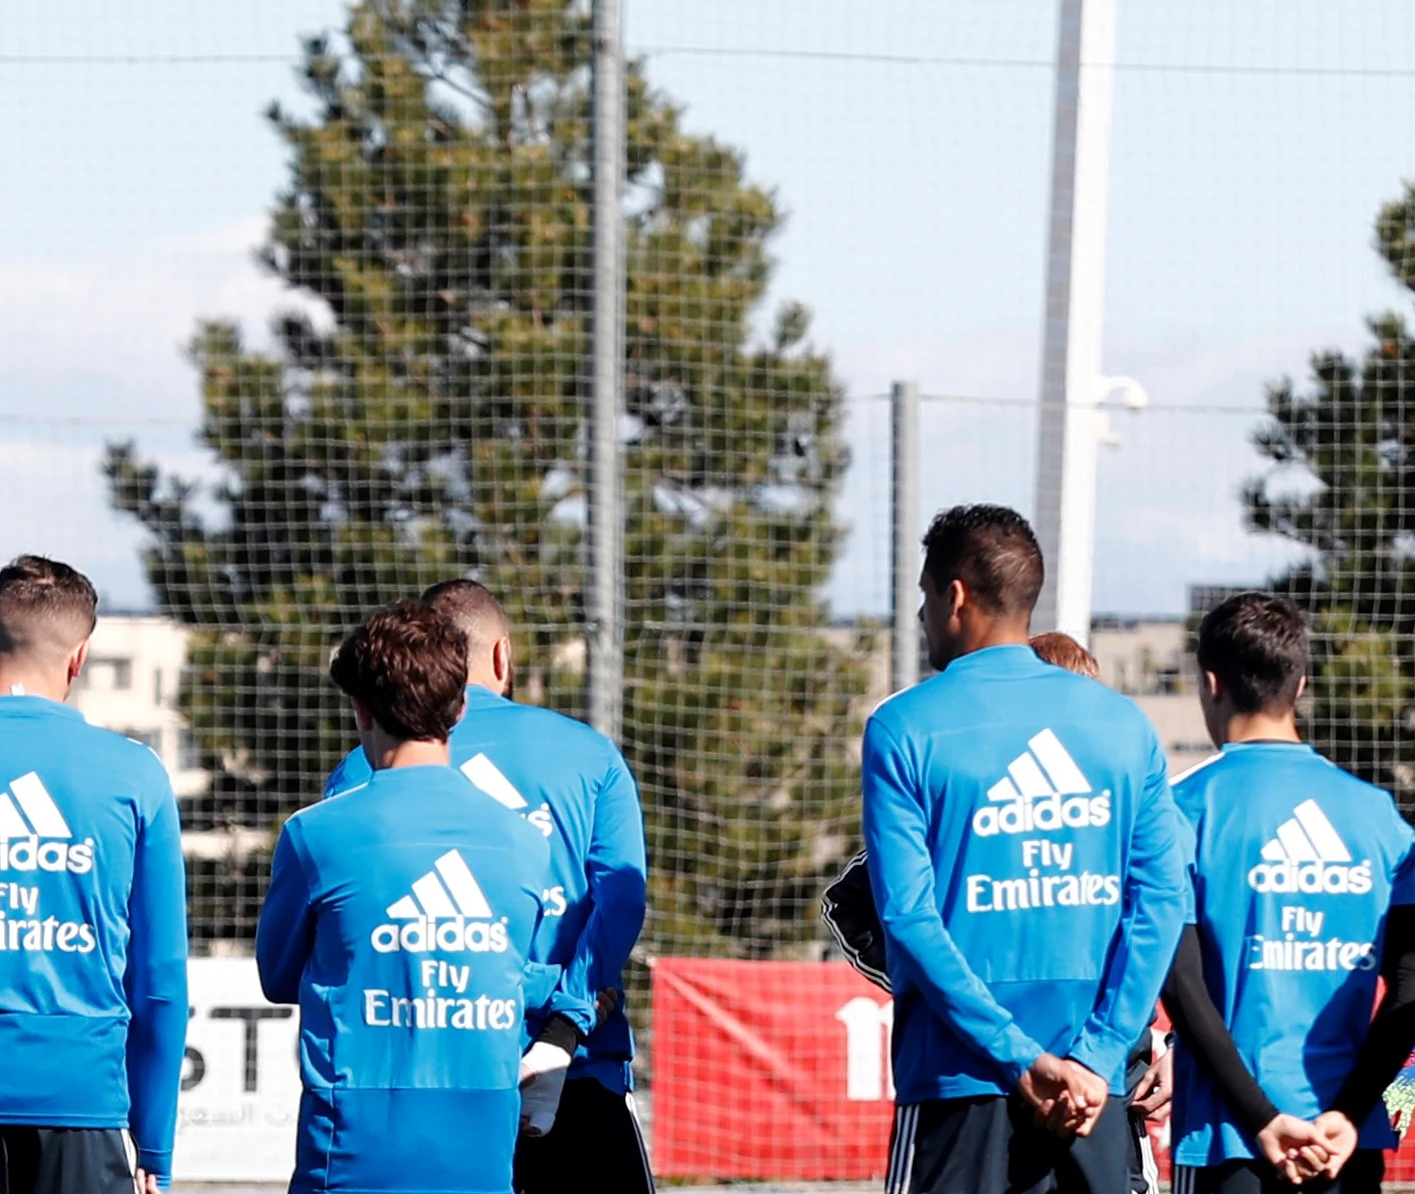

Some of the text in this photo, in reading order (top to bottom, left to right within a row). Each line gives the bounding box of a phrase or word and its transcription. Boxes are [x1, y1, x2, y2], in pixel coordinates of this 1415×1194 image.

[972, 791, 1111, 837] adidas
[1022, 839, 1072, 871] Fly
[966, 868, 1120, 913] Emirates
[1247, 859, 1373, 894] adidas
[371, 914, 508, 953] adidas
[1281, 906, 1323, 937] Fly
[1246, 933, 1377, 971] Emirates
[421, 960, 470, 993] Fly
[363, 988, 515, 1030] Emirates
